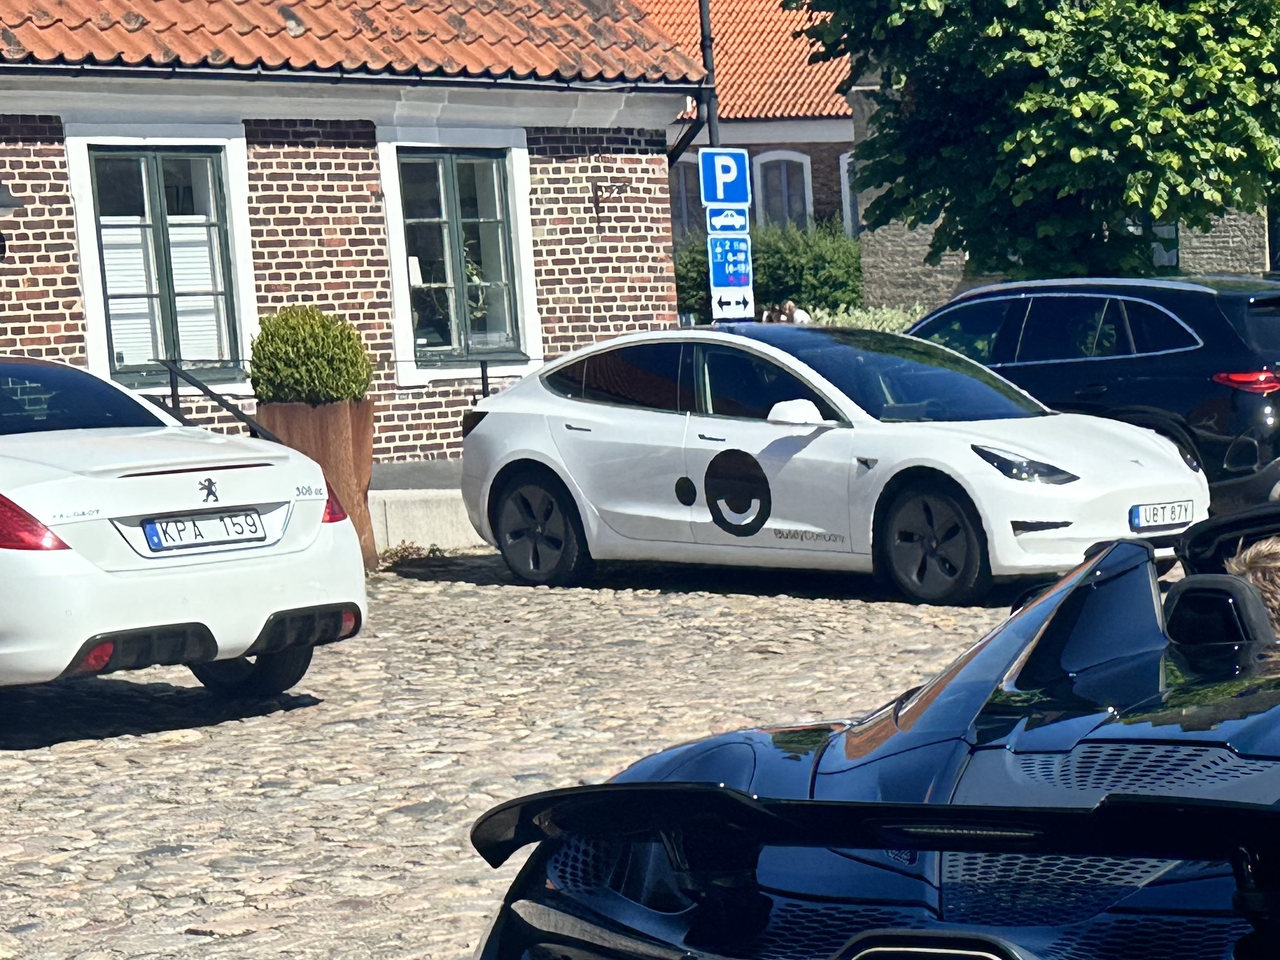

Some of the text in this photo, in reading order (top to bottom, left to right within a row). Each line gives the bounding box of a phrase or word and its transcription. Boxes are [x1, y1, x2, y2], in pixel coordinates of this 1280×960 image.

[714, 156, 738, 200] P
[160, 512, 259, 543] KPA 159
[1144, 503, 1189, 523] UBT 87Y
